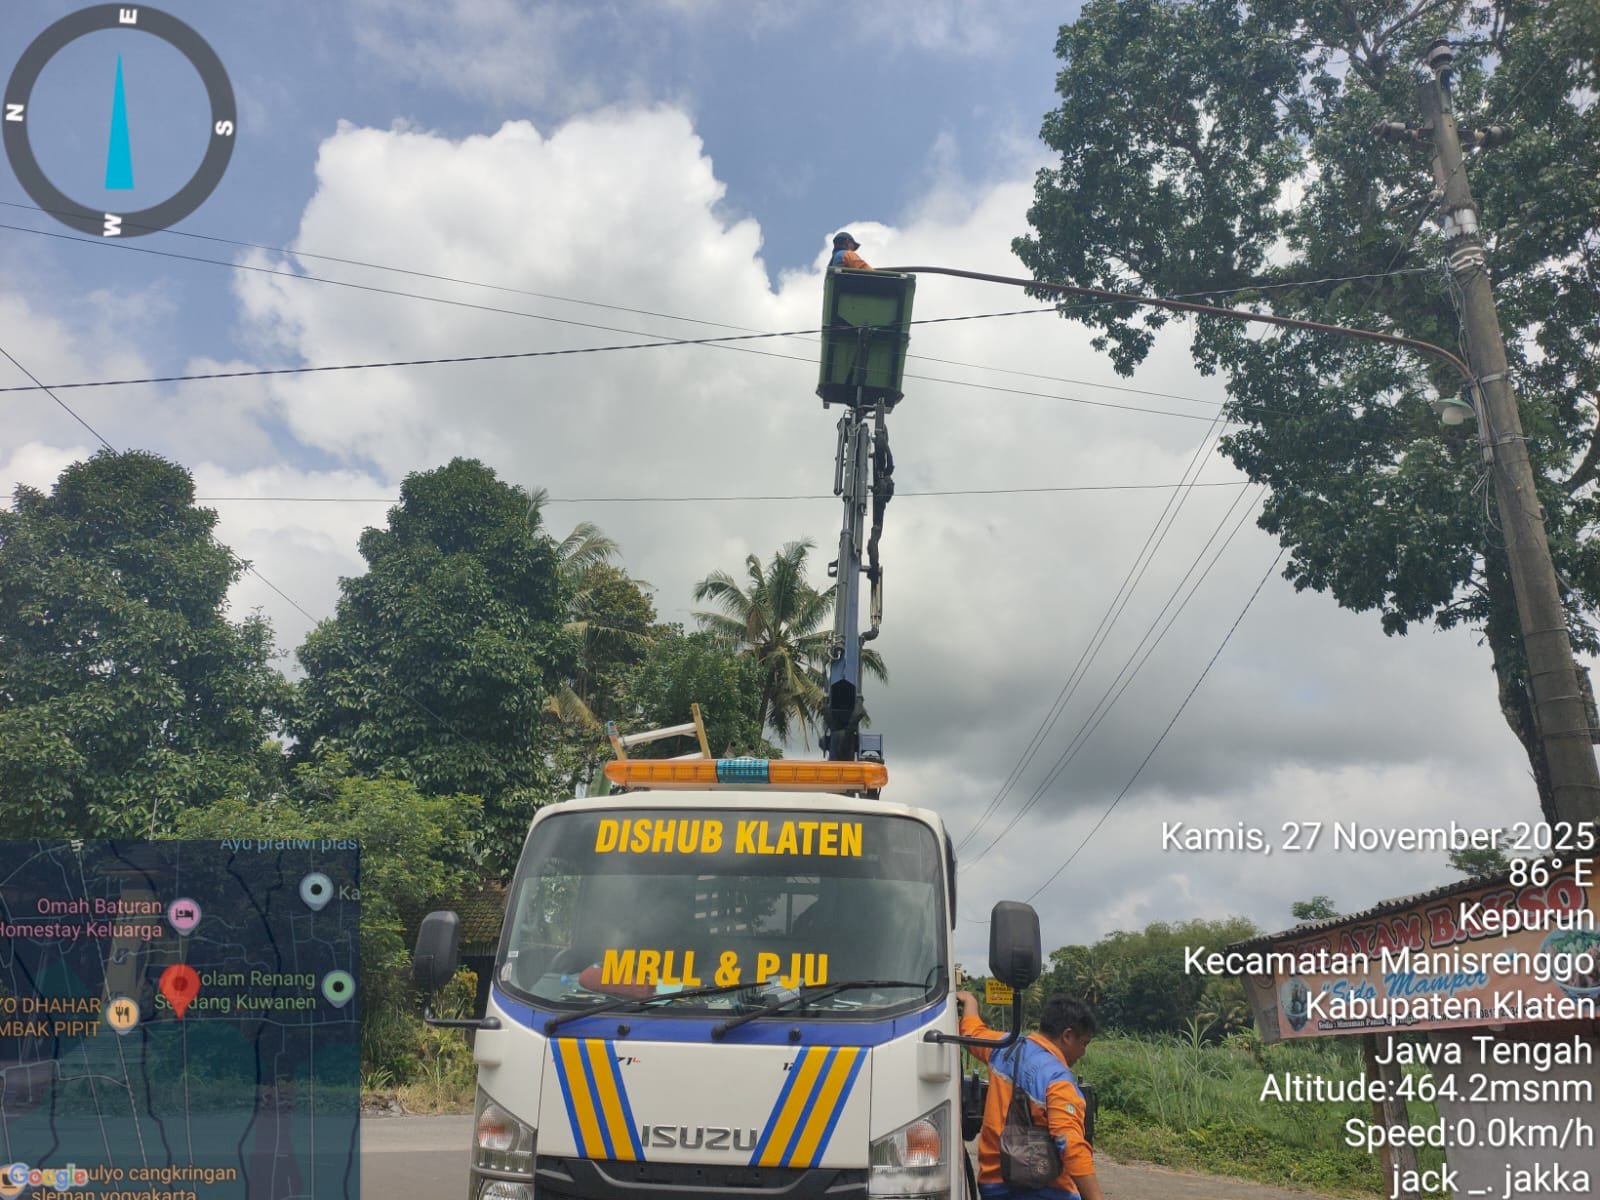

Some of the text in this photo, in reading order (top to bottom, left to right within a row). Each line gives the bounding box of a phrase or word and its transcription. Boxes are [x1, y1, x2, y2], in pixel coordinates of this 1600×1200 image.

[595, 819, 862, 857] DISHUB KLATEN
[601, 949, 828, 990] MRLL & PJU
[641, 1124, 758, 1152] ISUZU
